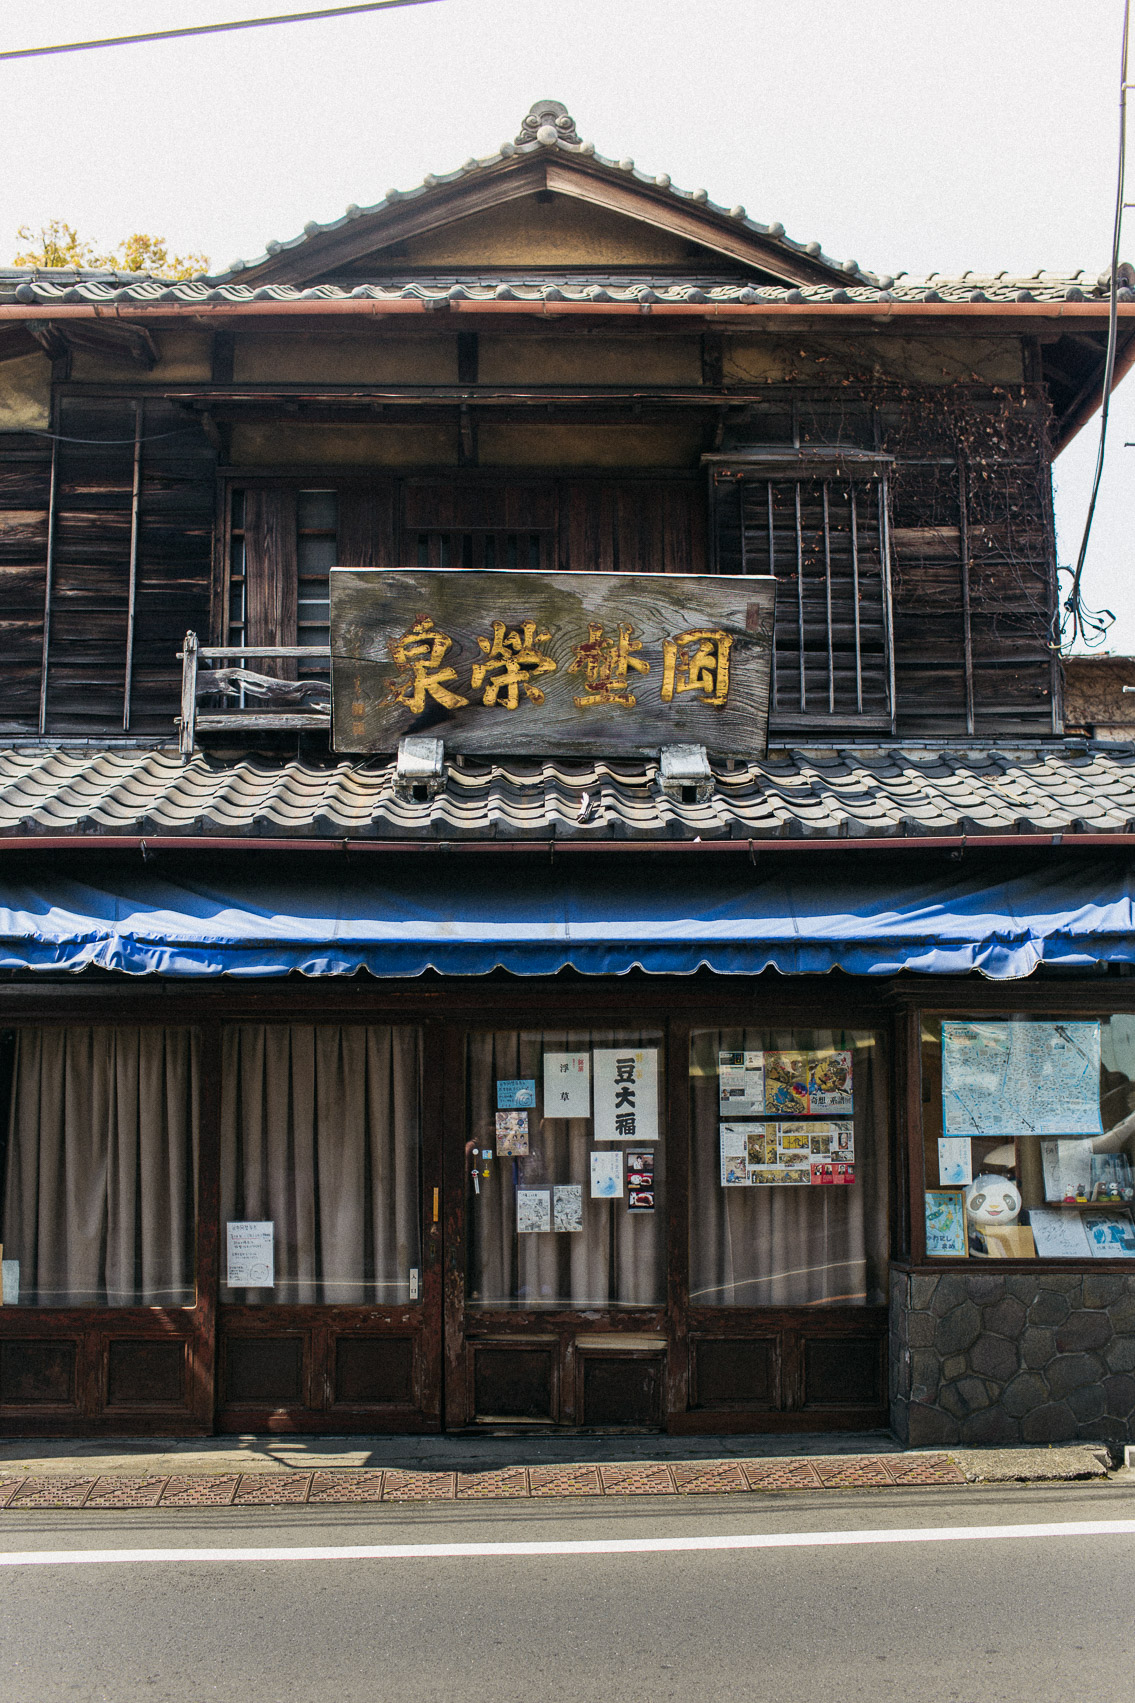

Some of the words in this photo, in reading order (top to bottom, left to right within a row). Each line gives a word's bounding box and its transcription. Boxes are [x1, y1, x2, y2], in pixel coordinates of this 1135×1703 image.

[560, 1063, 570, 1102] 浮草
[614, 1057, 636, 1136] 豆大福
[411, 1274, 417, 1294] 入口
